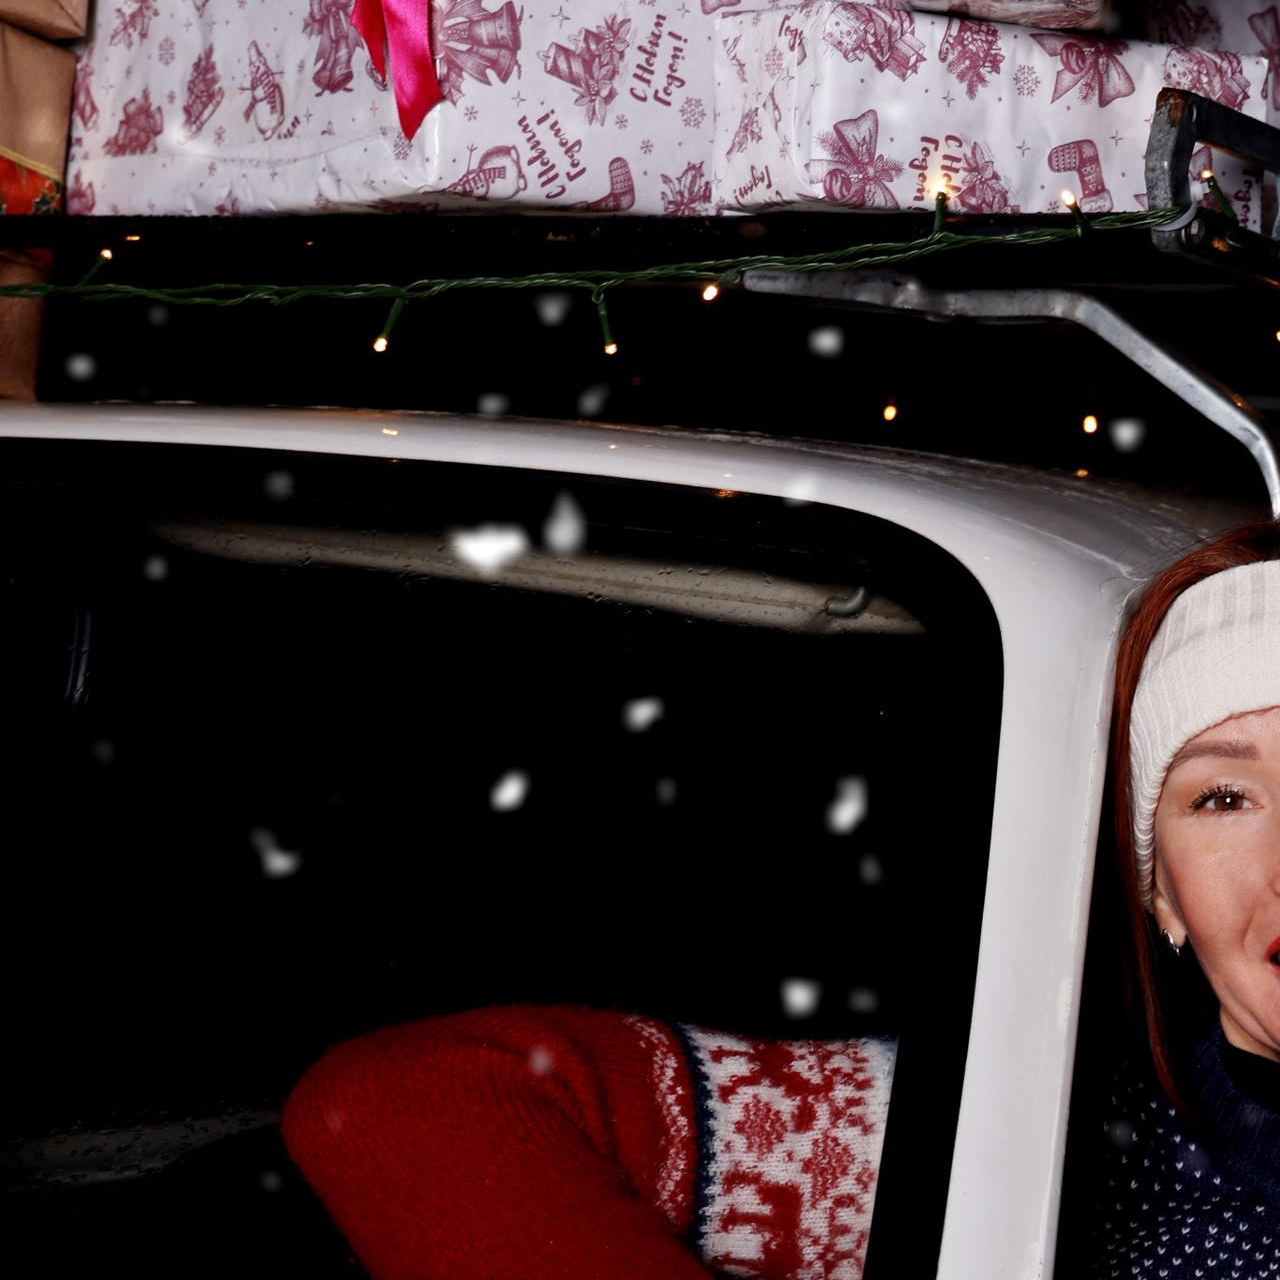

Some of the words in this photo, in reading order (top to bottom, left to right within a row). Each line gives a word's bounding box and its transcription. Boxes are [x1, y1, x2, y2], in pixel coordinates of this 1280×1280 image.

[652, 31, 688, 107] Годом!
[629, 87, 648, 102] С
[536, 108, 587, 182] Годом!
[545, 184, 566, 199] С
